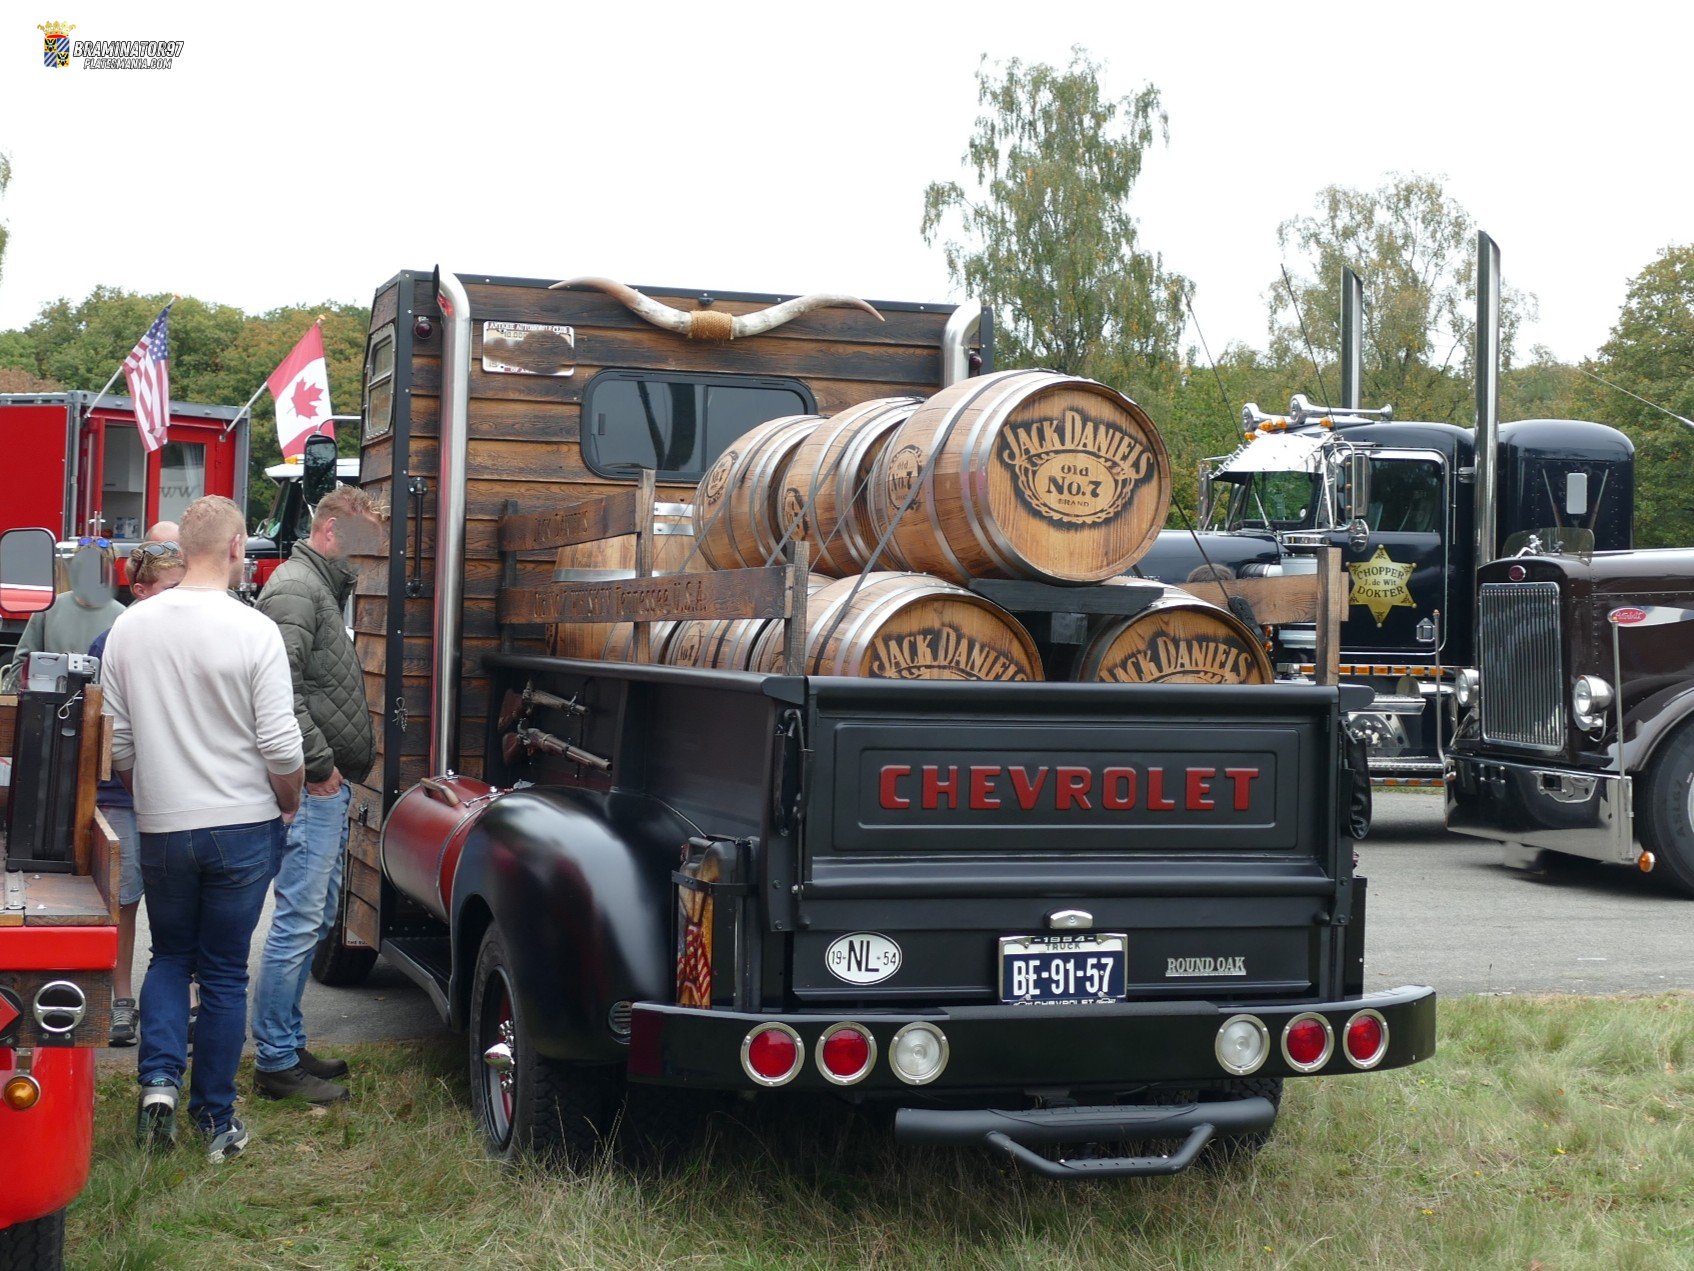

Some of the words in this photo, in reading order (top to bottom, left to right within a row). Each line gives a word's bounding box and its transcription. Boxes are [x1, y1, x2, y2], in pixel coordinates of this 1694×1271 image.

[1003, 420, 1060, 465] JACK
[1061, 464, 1089, 476] Old
[1357, 566, 1404, 580] CHOPPER
[1357, 586, 1404, 597] DOKTER
[872, 634, 936, 678] JACK
[879, 764, 1260, 811] CHEVROLET
[847, 940, 880, 973] NL
[1045, 943, 1081, 951] TRUCK
[1013, 957, 1114, 996] BE-91-57
[1167, 957, 1215, 973] ROUND
[1217, 956, 1246, 973] OAK
